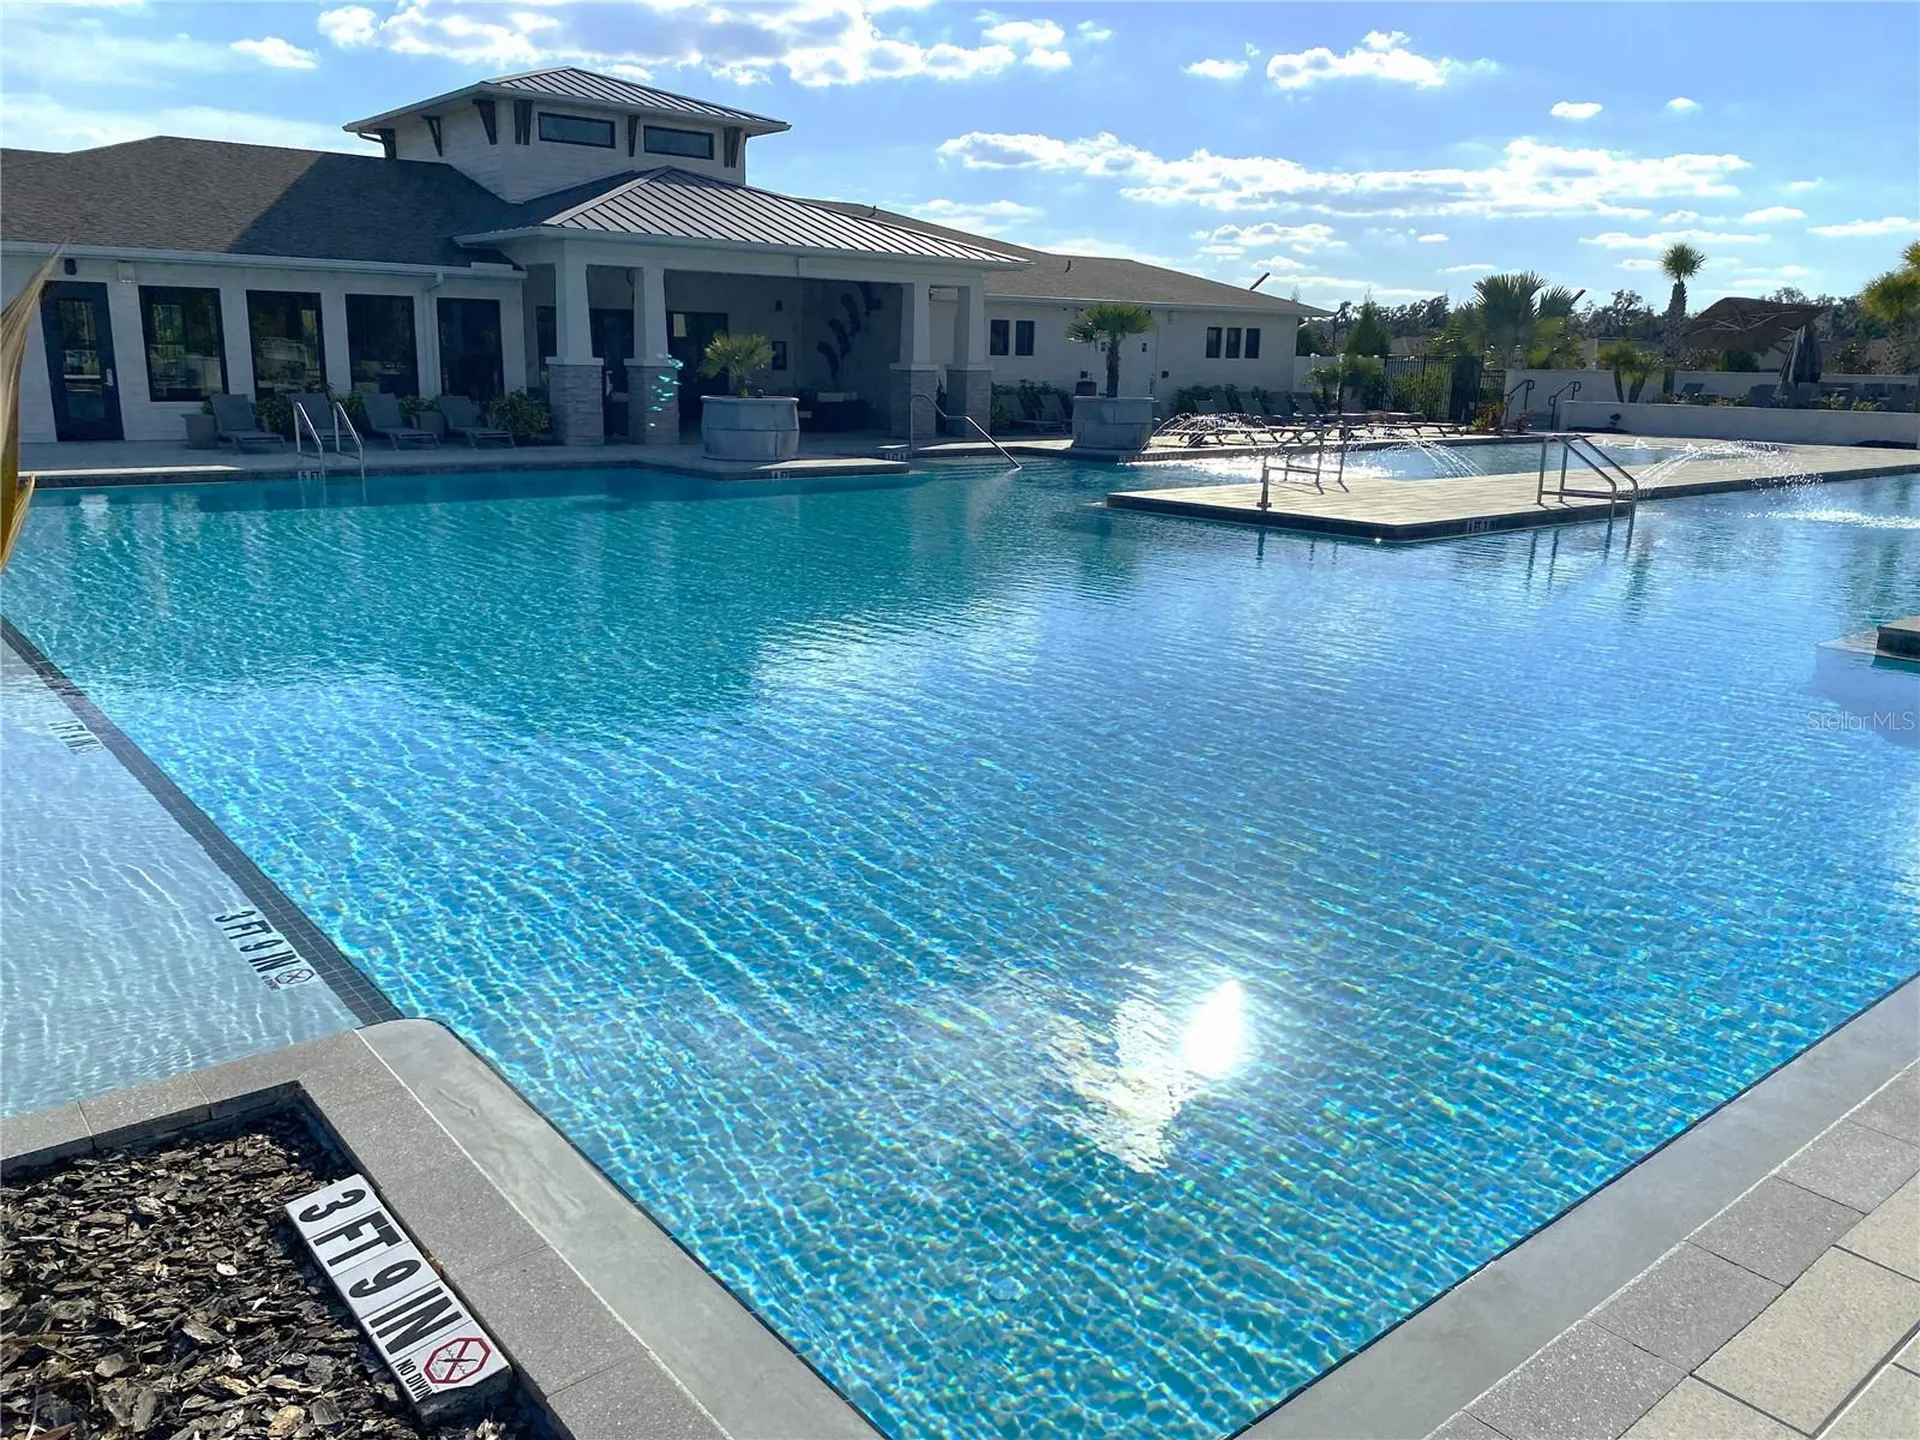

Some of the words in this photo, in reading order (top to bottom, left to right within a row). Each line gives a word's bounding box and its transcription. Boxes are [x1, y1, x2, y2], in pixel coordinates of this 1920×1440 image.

[214, 910, 256, 922] 3
[223, 920, 274, 940] FT
[240, 939, 284, 952] 9
[248, 950, 301, 973] IN
[298, 1188, 366, 1223] 3
[313, 1210, 402, 1267] FT
[348, 1259, 421, 1299] 9
[368, 1285, 463, 1355] IN
[395, 1358, 417, 1376] NO
